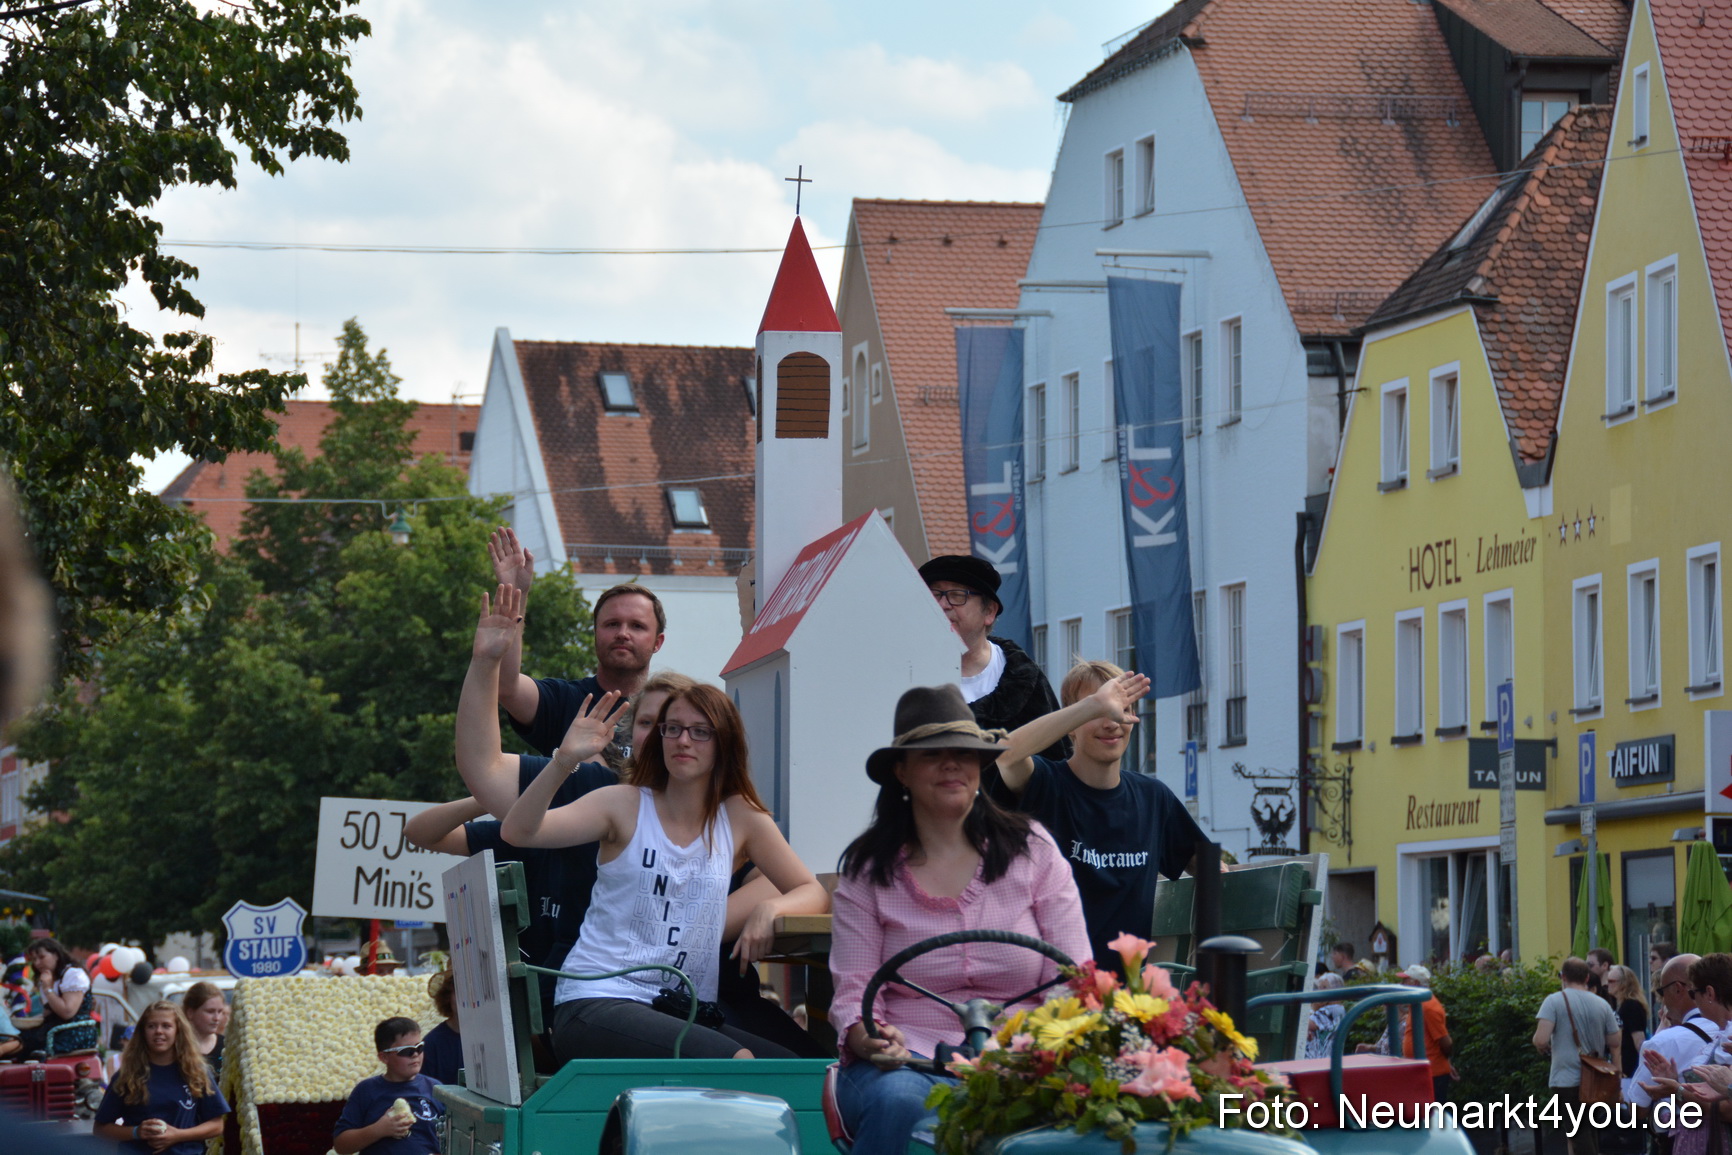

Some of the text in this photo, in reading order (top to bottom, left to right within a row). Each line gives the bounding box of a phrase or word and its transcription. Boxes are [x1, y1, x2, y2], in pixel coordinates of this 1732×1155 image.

[970, 460, 1018, 575] K&L
[1408, 527, 1537, 593] HOTEL Lehmeier
[1500, 691, 1510, 744] P
[1187, 748, 1196, 791] P
[1474, 770, 1542, 784] TAUN
[1581, 742, 1592, 796] P
[1606, 743, 1660, 779] TAIFUN
[1406, 793, 1481, 830] Restaurant
[340, 811, 381, 851] 50
[1070, 839, 1149, 870] Lutheraner
[353, 865, 434, 910] Mini's
[253, 915, 276, 935] SV
[238, 937, 294, 960] STAUF
[251, 961, 281, 975] 1980
